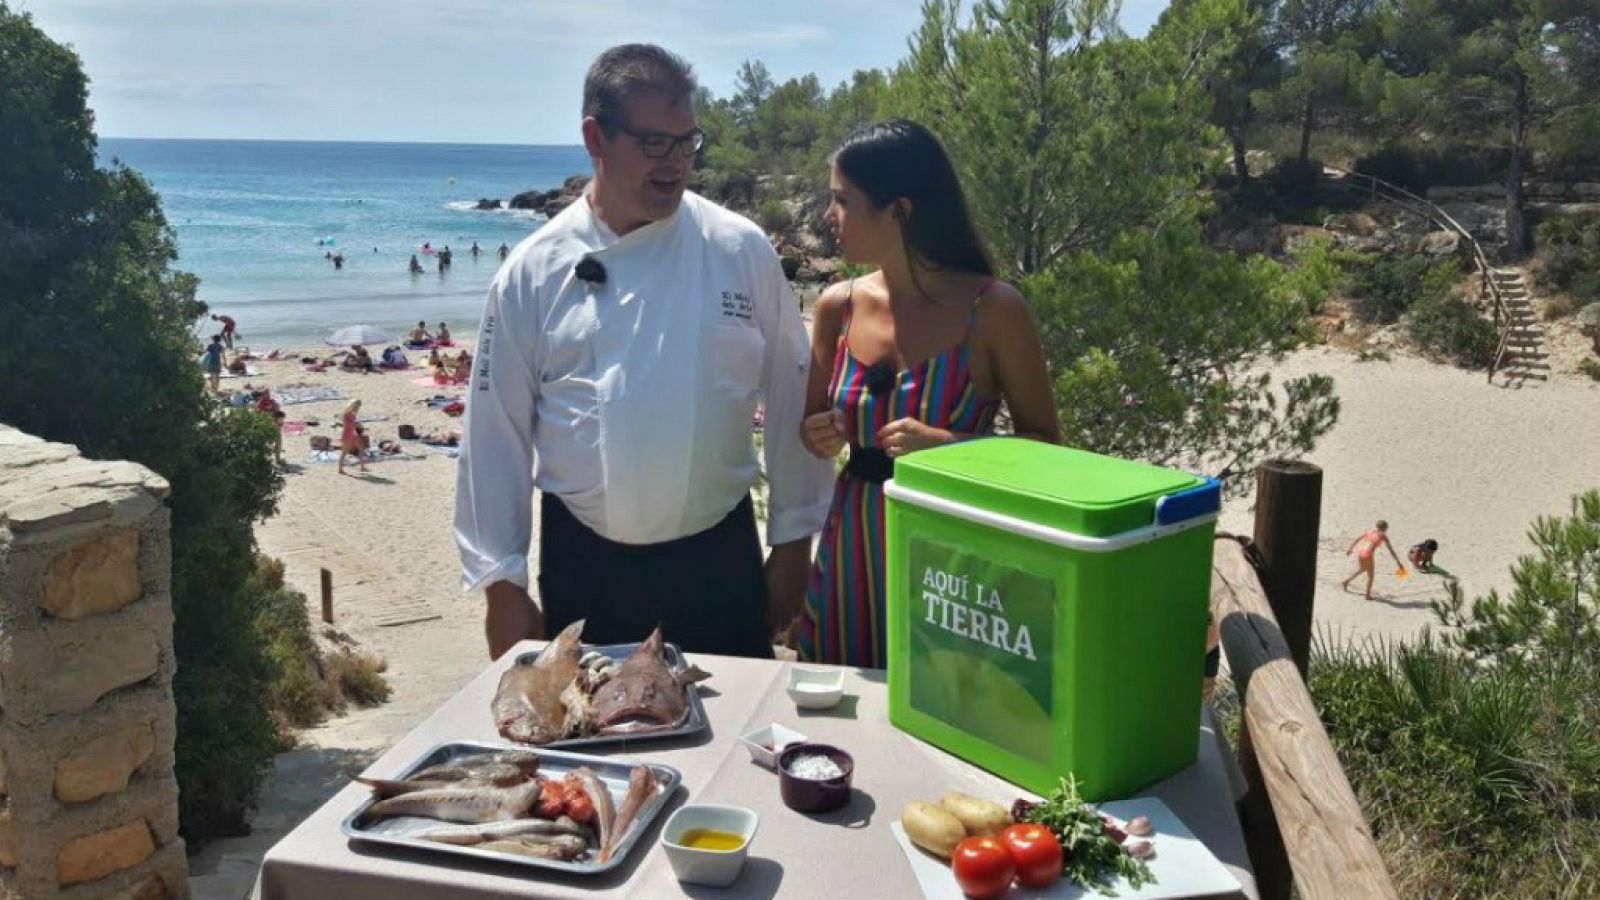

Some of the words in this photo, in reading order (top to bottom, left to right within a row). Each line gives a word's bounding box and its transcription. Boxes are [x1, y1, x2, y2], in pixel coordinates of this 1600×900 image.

[923, 566, 969, 601] AQUÍ
[976, 583, 1004, 612] LA
[923, 590, 1037, 661] TIERRA
